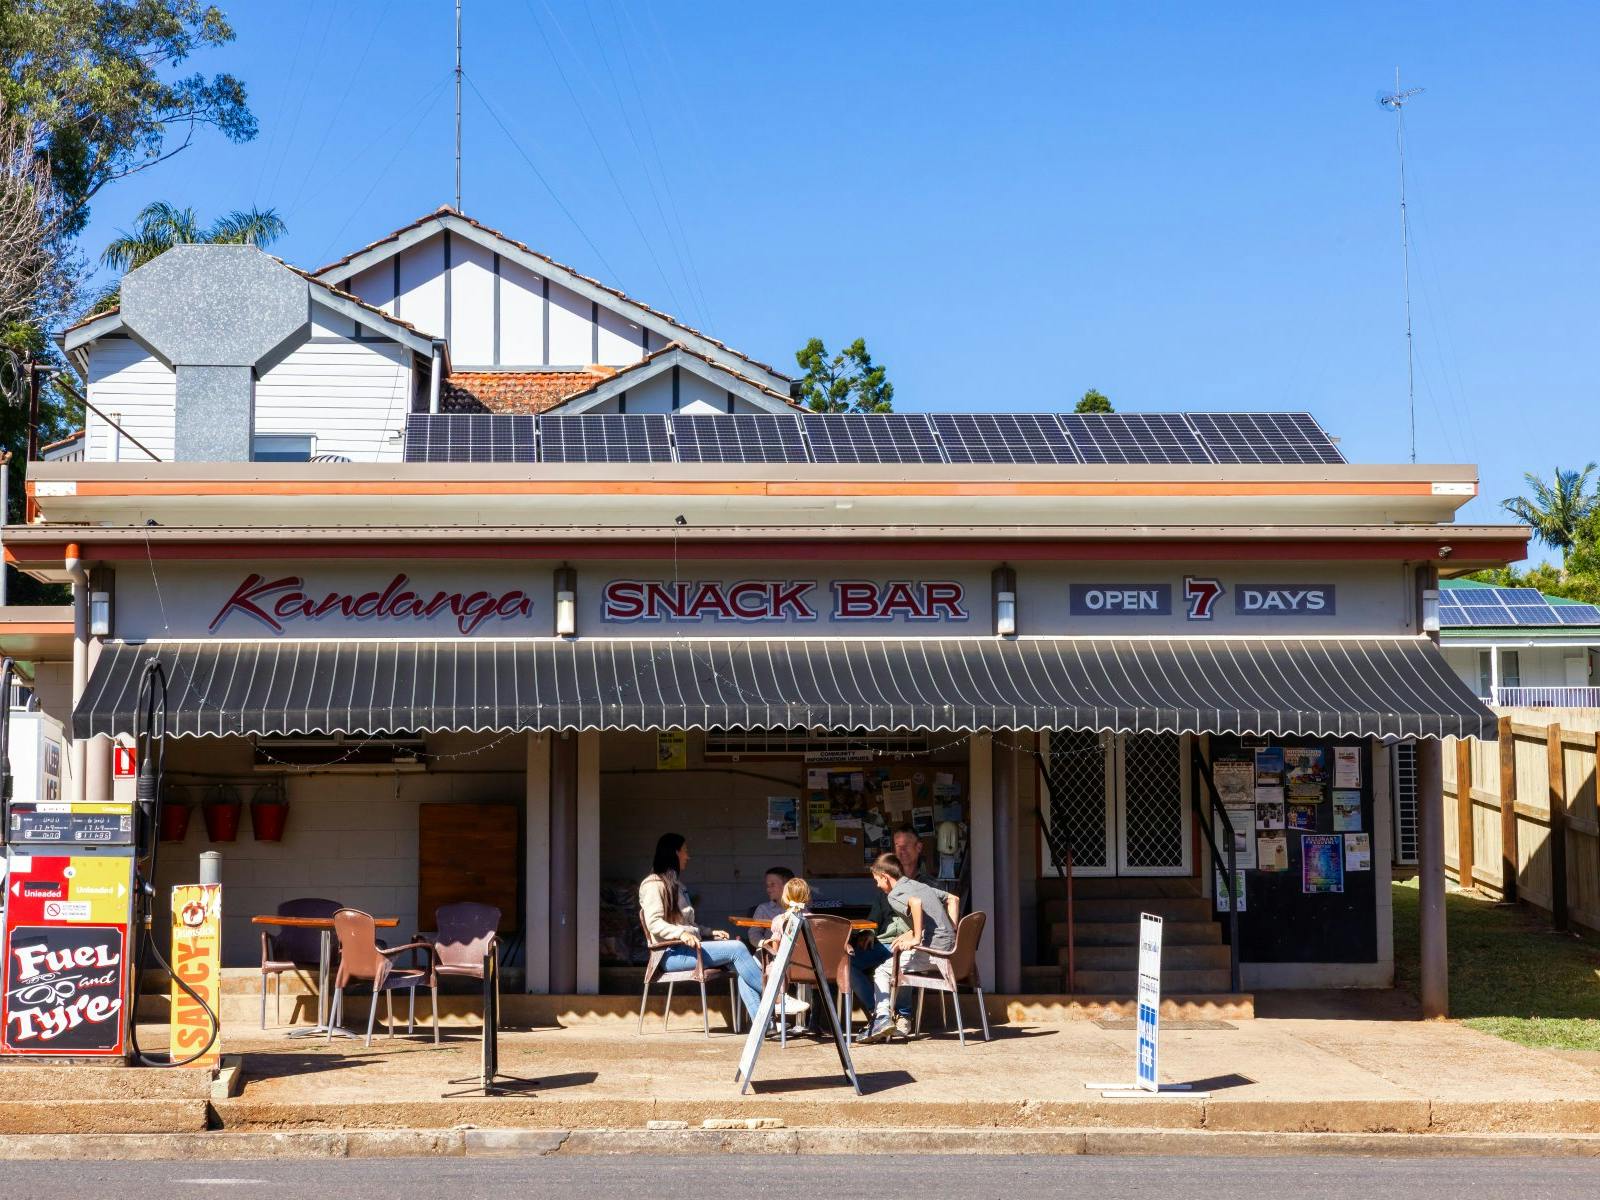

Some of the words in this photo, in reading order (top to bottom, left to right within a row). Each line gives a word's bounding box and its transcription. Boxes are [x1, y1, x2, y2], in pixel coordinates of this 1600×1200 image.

[208, 573, 534, 635] Kandanga
[602, 579, 818, 623] SNACK
[829, 579, 970, 623] BAR
[1085, 590, 1160, 610] OPEN
[1183, 574, 1227, 621] 7
[1244, 590, 1326, 610] DAYS
[24, 889, 62, 898] Unleaded
[76, 886, 114, 894] Unleaded
[12, 943, 120, 983] Fuel
[78, 969, 117, 988] and
[177, 942, 210, 1049] SAUCY
[7, 994, 123, 1042] Tyre
